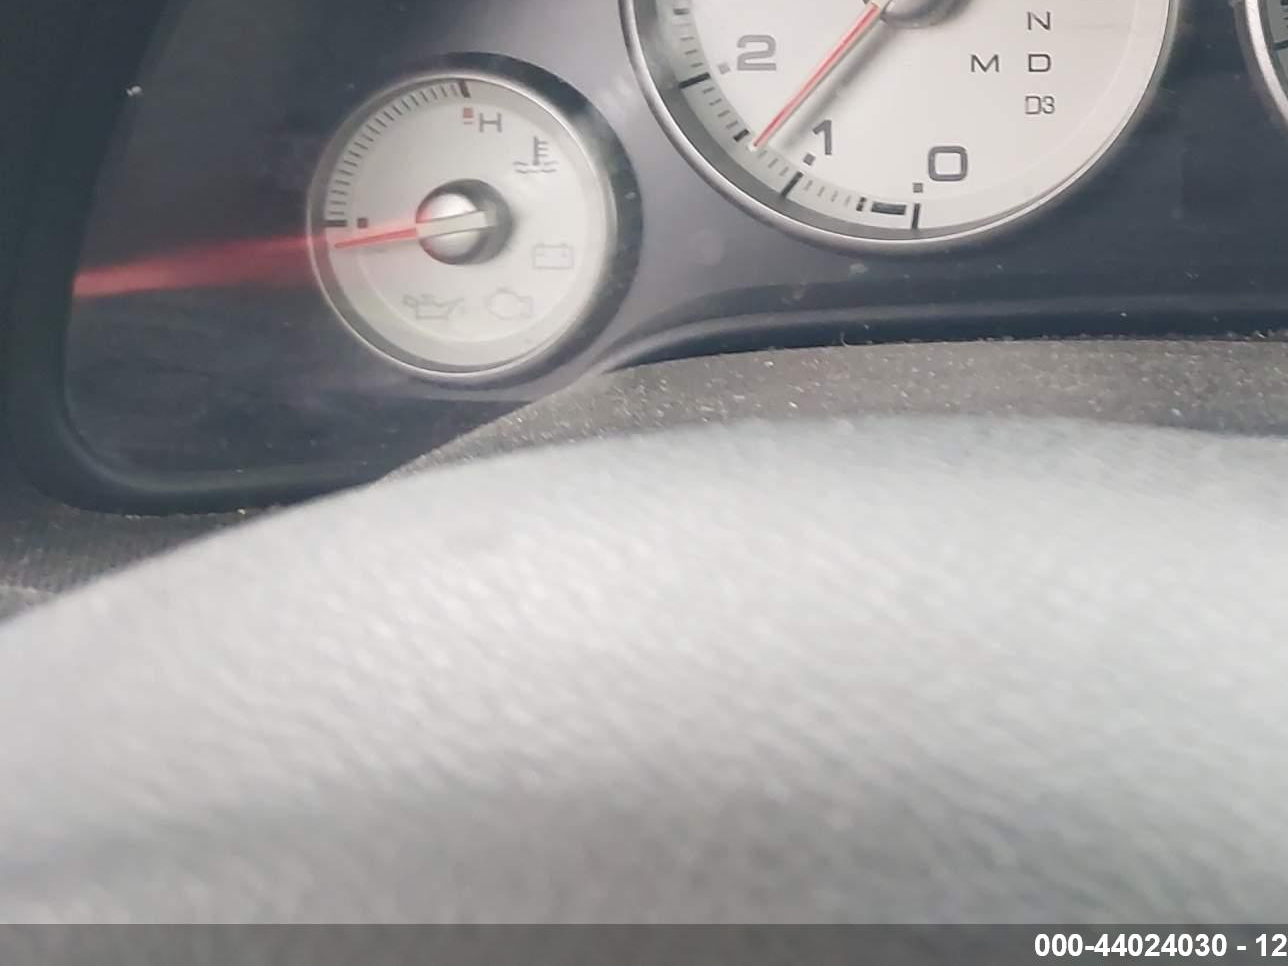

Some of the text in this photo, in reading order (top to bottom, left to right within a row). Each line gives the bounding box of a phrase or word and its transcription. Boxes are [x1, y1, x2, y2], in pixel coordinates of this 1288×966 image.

[1027, 12, 1051, 31] N
[736, 34, 777, 71] 2
[970, 54, 1052, 73] M D
[1024, 95, 1056, 115] D3
[479, 113, 503, 132] H
[813, 120, 833, 155] 1
[928, 146, 968, 182] 0
